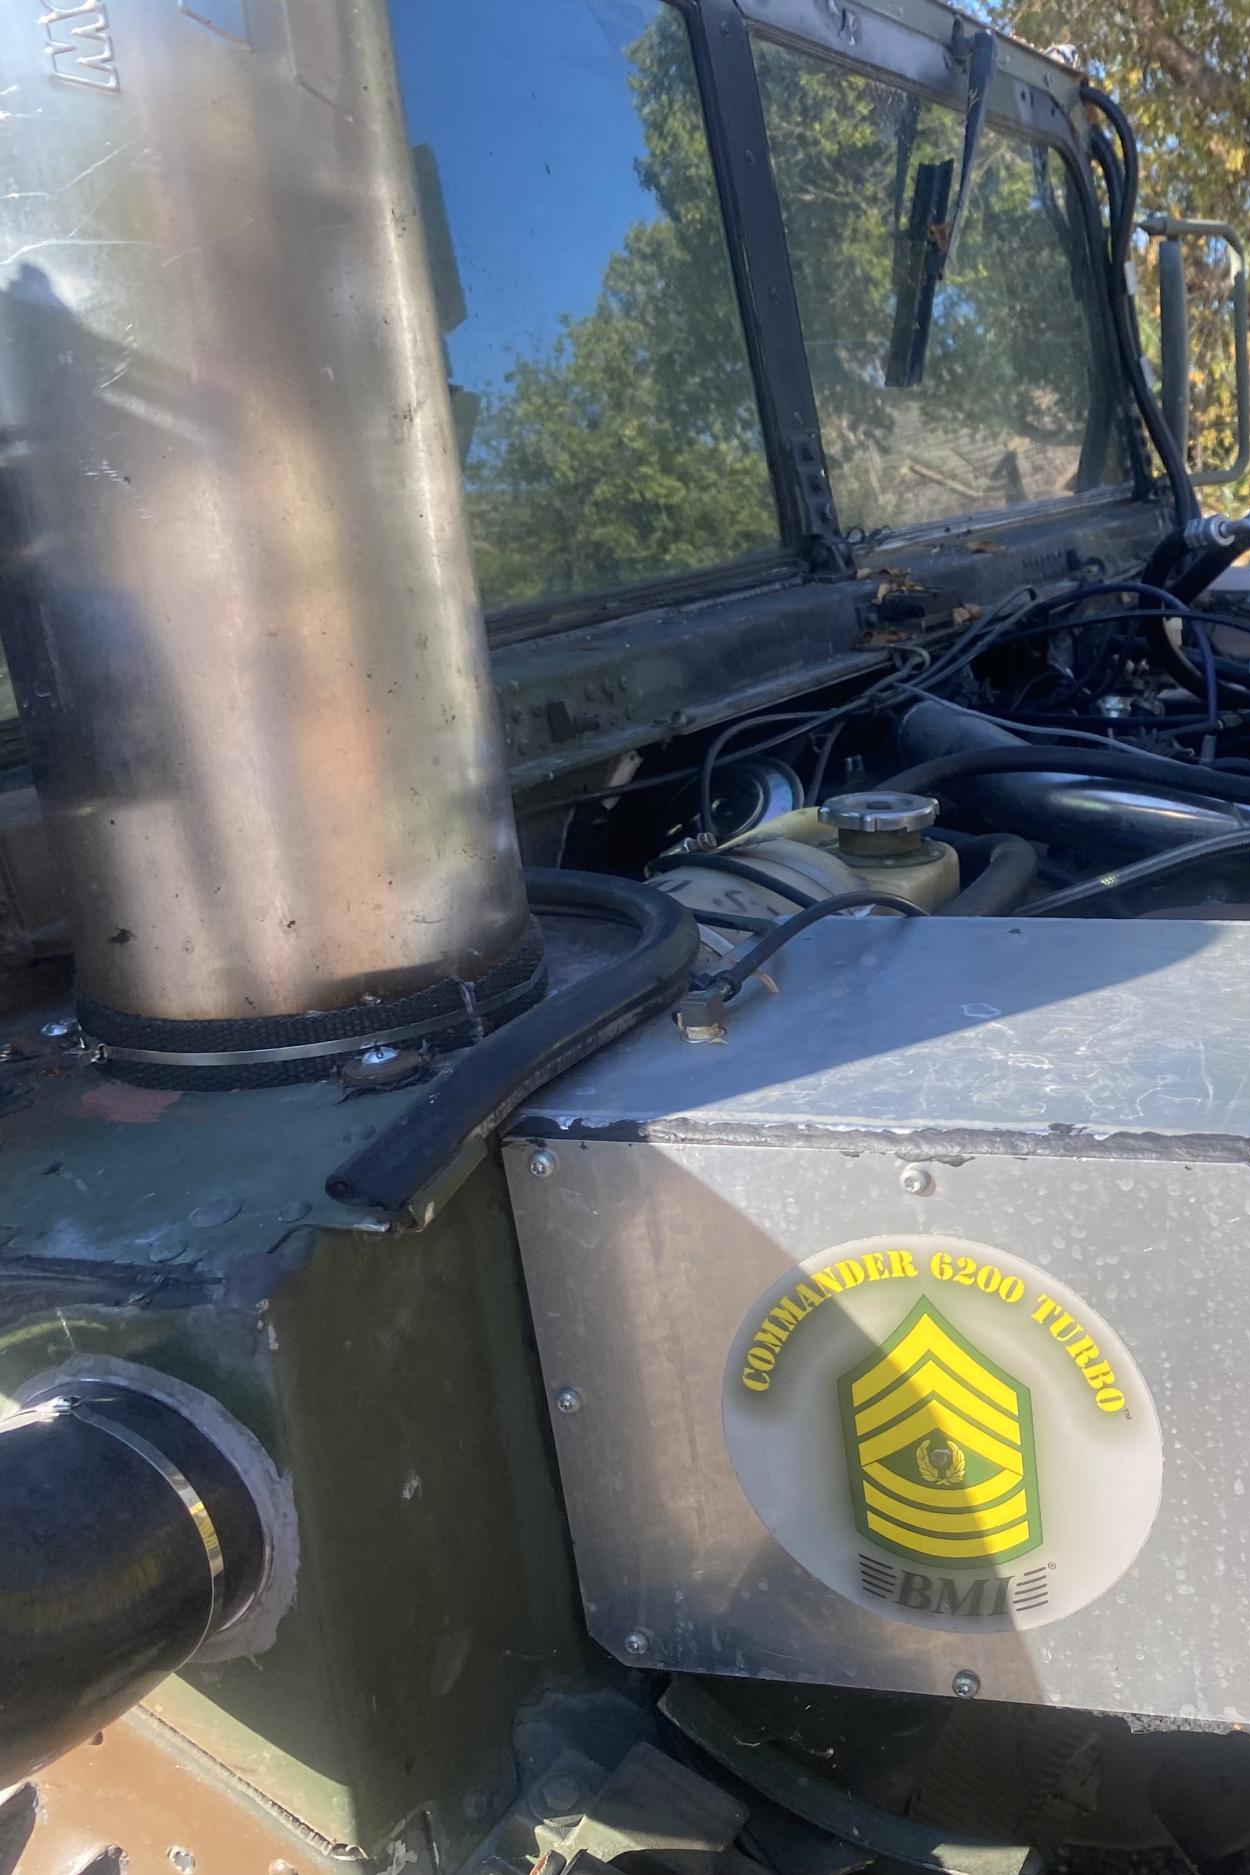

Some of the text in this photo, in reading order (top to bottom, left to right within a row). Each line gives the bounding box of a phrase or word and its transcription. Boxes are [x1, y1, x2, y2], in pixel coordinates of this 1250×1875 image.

[742, 1249, 919, 1392] COMMANDER
[930, 1251, 1025, 1304] 6200
[1030, 1294, 1126, 1412] TURBO
[893, 1568, 1016, 1617] BMI
